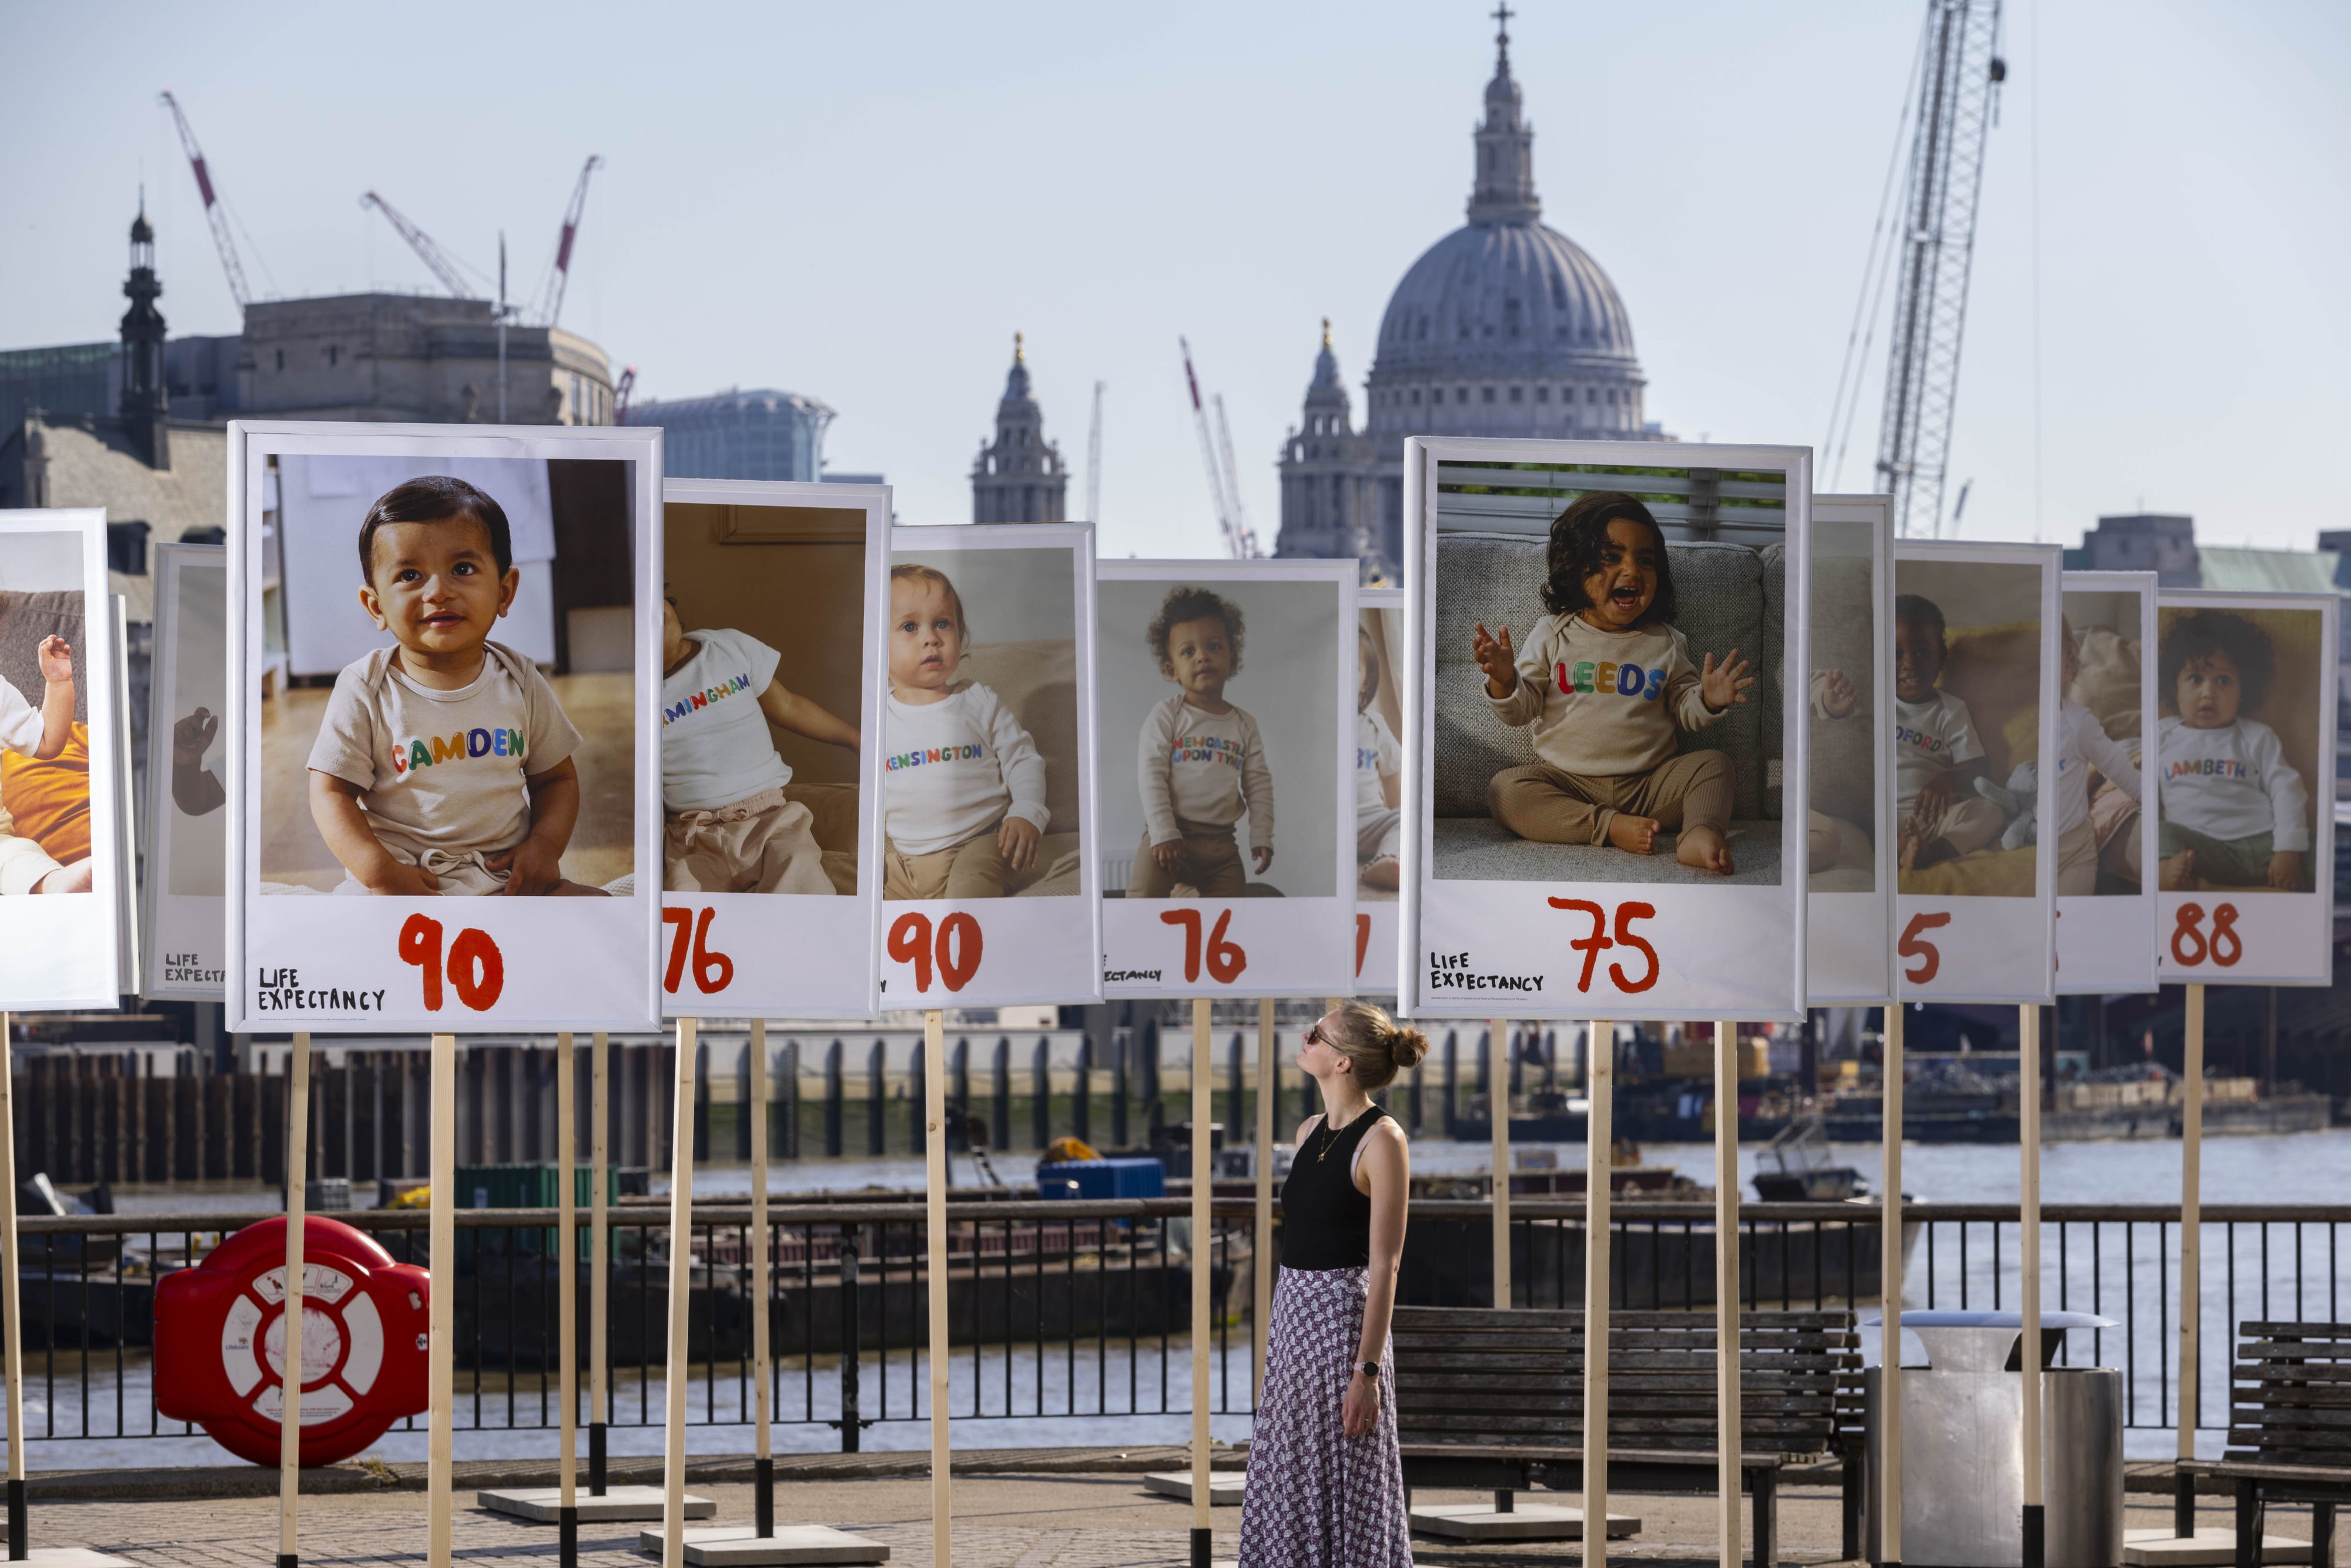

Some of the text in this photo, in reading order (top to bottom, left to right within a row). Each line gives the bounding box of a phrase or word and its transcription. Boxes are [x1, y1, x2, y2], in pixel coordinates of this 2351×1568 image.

[1556, 661, 1666, 701] LEEDS
[392, 728, 524, 773] CAMDEN
[1173, 749, 1212, 762] UPON
[2164, 758, 2246, 781] LAMBETH
[662, 907, 734, 994] 76
[1160, 909, 1247, 983] 76
[1548, 896, 1659, 993] 75
[2171, 903, 2242, 967] 88
[166, 953, 199, 967] LIFE
[398, 913, 504, 1011] 90
[888, 912, 983, 993] 90
[1431, 951, 1469, 969] LIFE
[260, 967, 299, 988] LIFE
[1104, 970, 1161, 981] ECTANCY
[1431, 970, 1543, 991] EXPECTANCY
[259, 989, 385, 1011] EXPECTANCY
